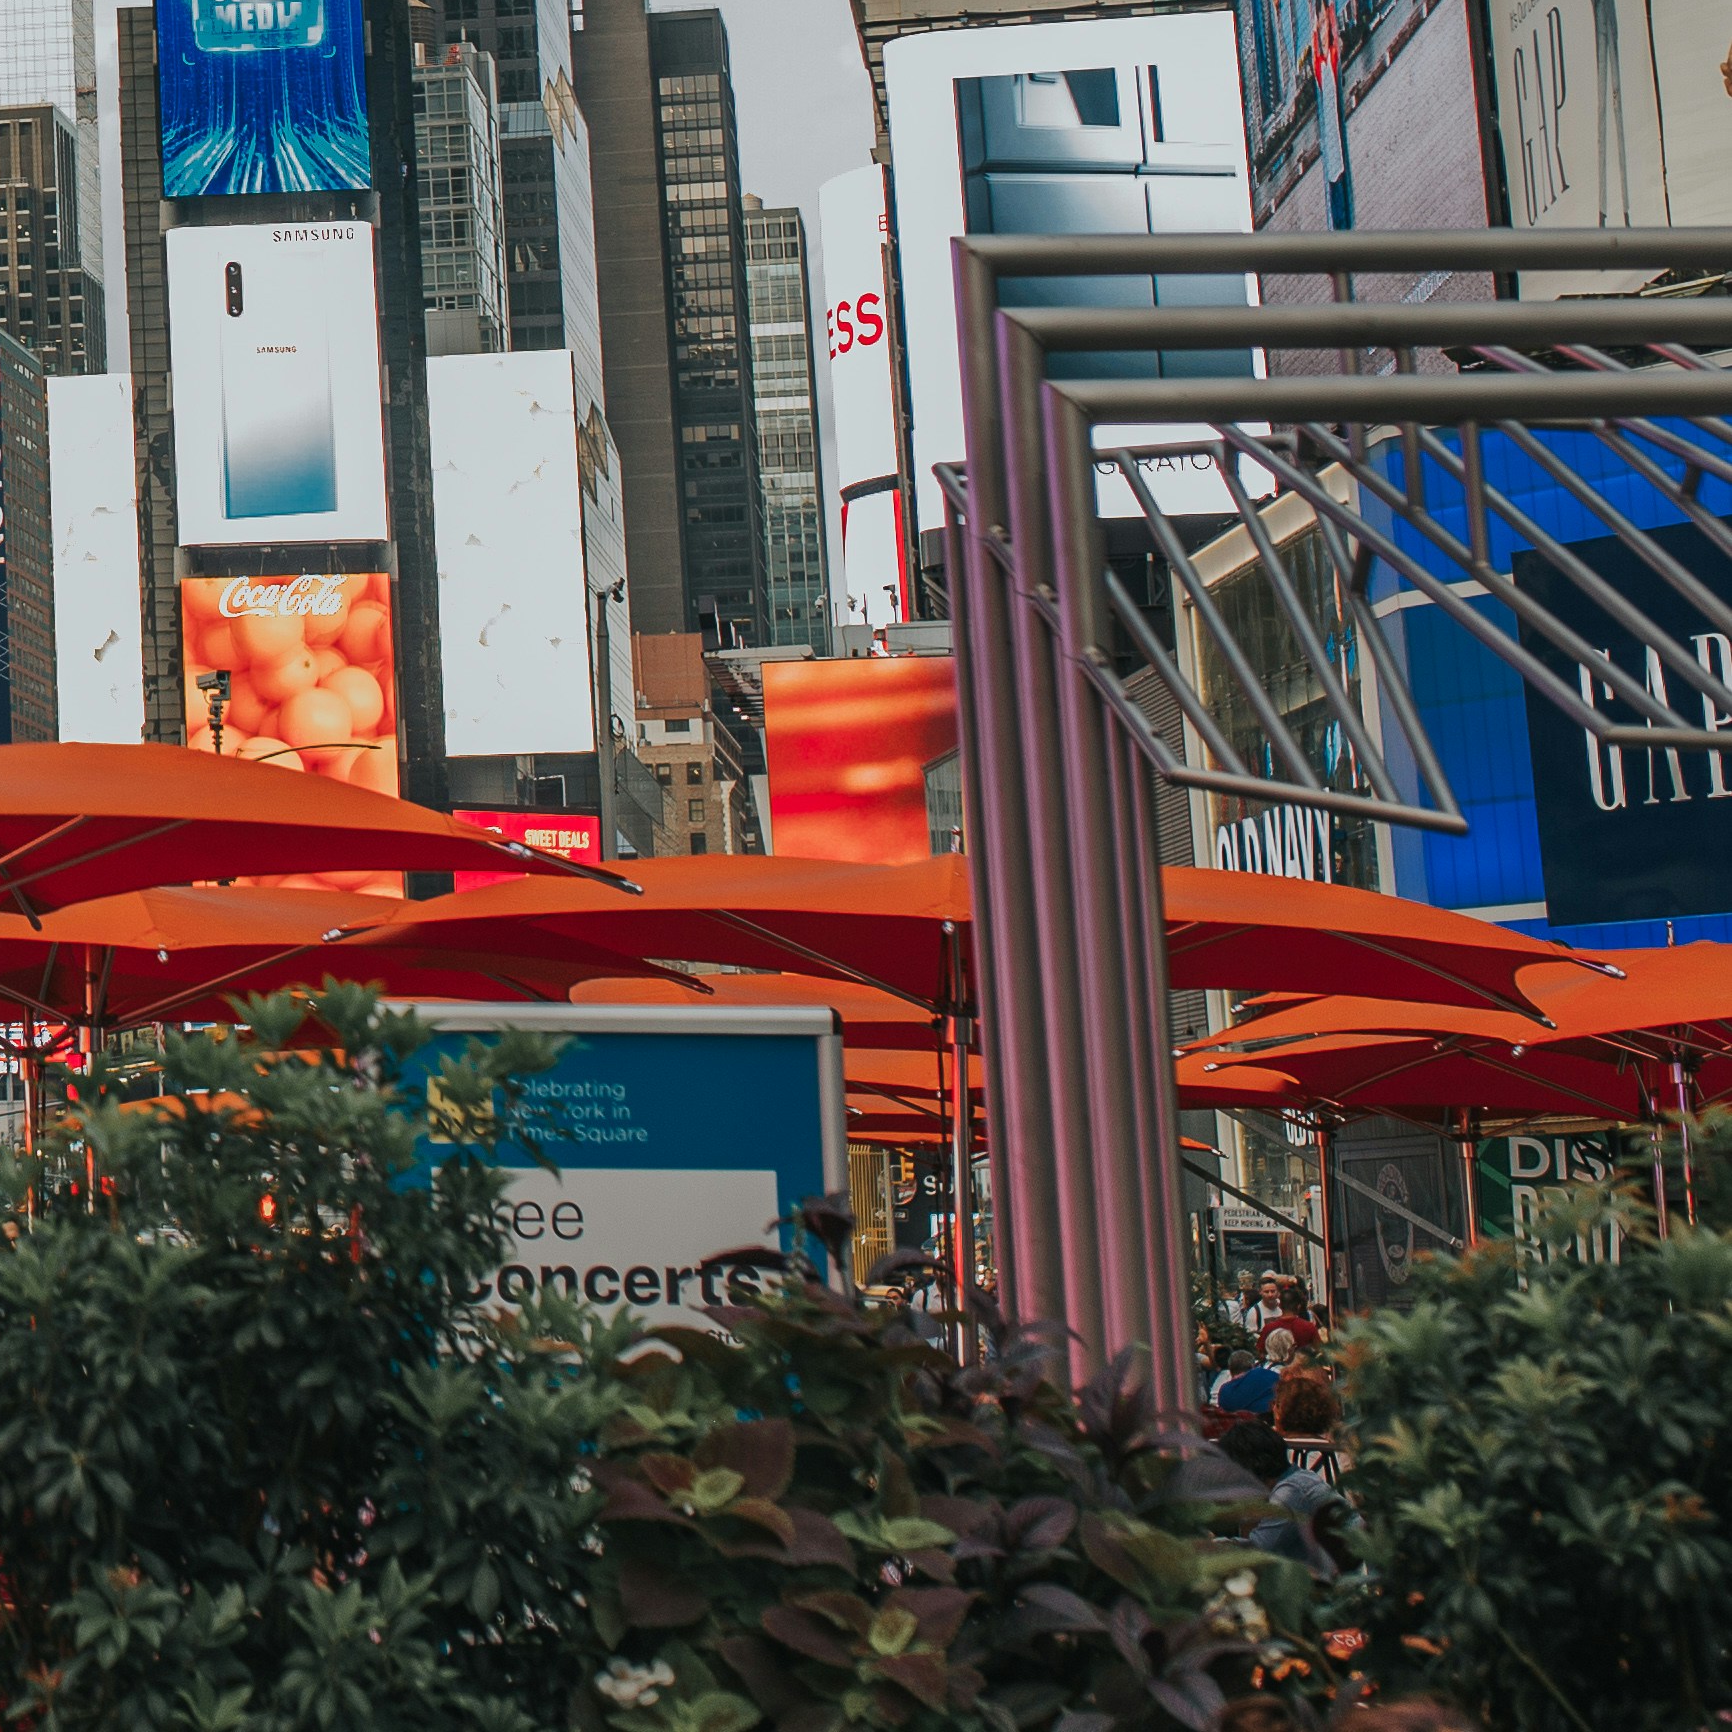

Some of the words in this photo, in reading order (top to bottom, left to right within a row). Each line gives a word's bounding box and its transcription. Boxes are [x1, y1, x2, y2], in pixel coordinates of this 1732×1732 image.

[1514, 6, 1570, 227] GAP
[272, 227, 355, 243] SAMSUNG
[256, 345, 297, 354] SAMSUNG
[219, 574, 348, 618] Coca-Cola
[1579, 632, 1732, 811] GAP
[524, 829, 557, 847] SWEET
[1263, 803, 1332, 884] NAVY
[574, 1124, 649, 1146] Square
[512, 1199, 585, 1241] ee
